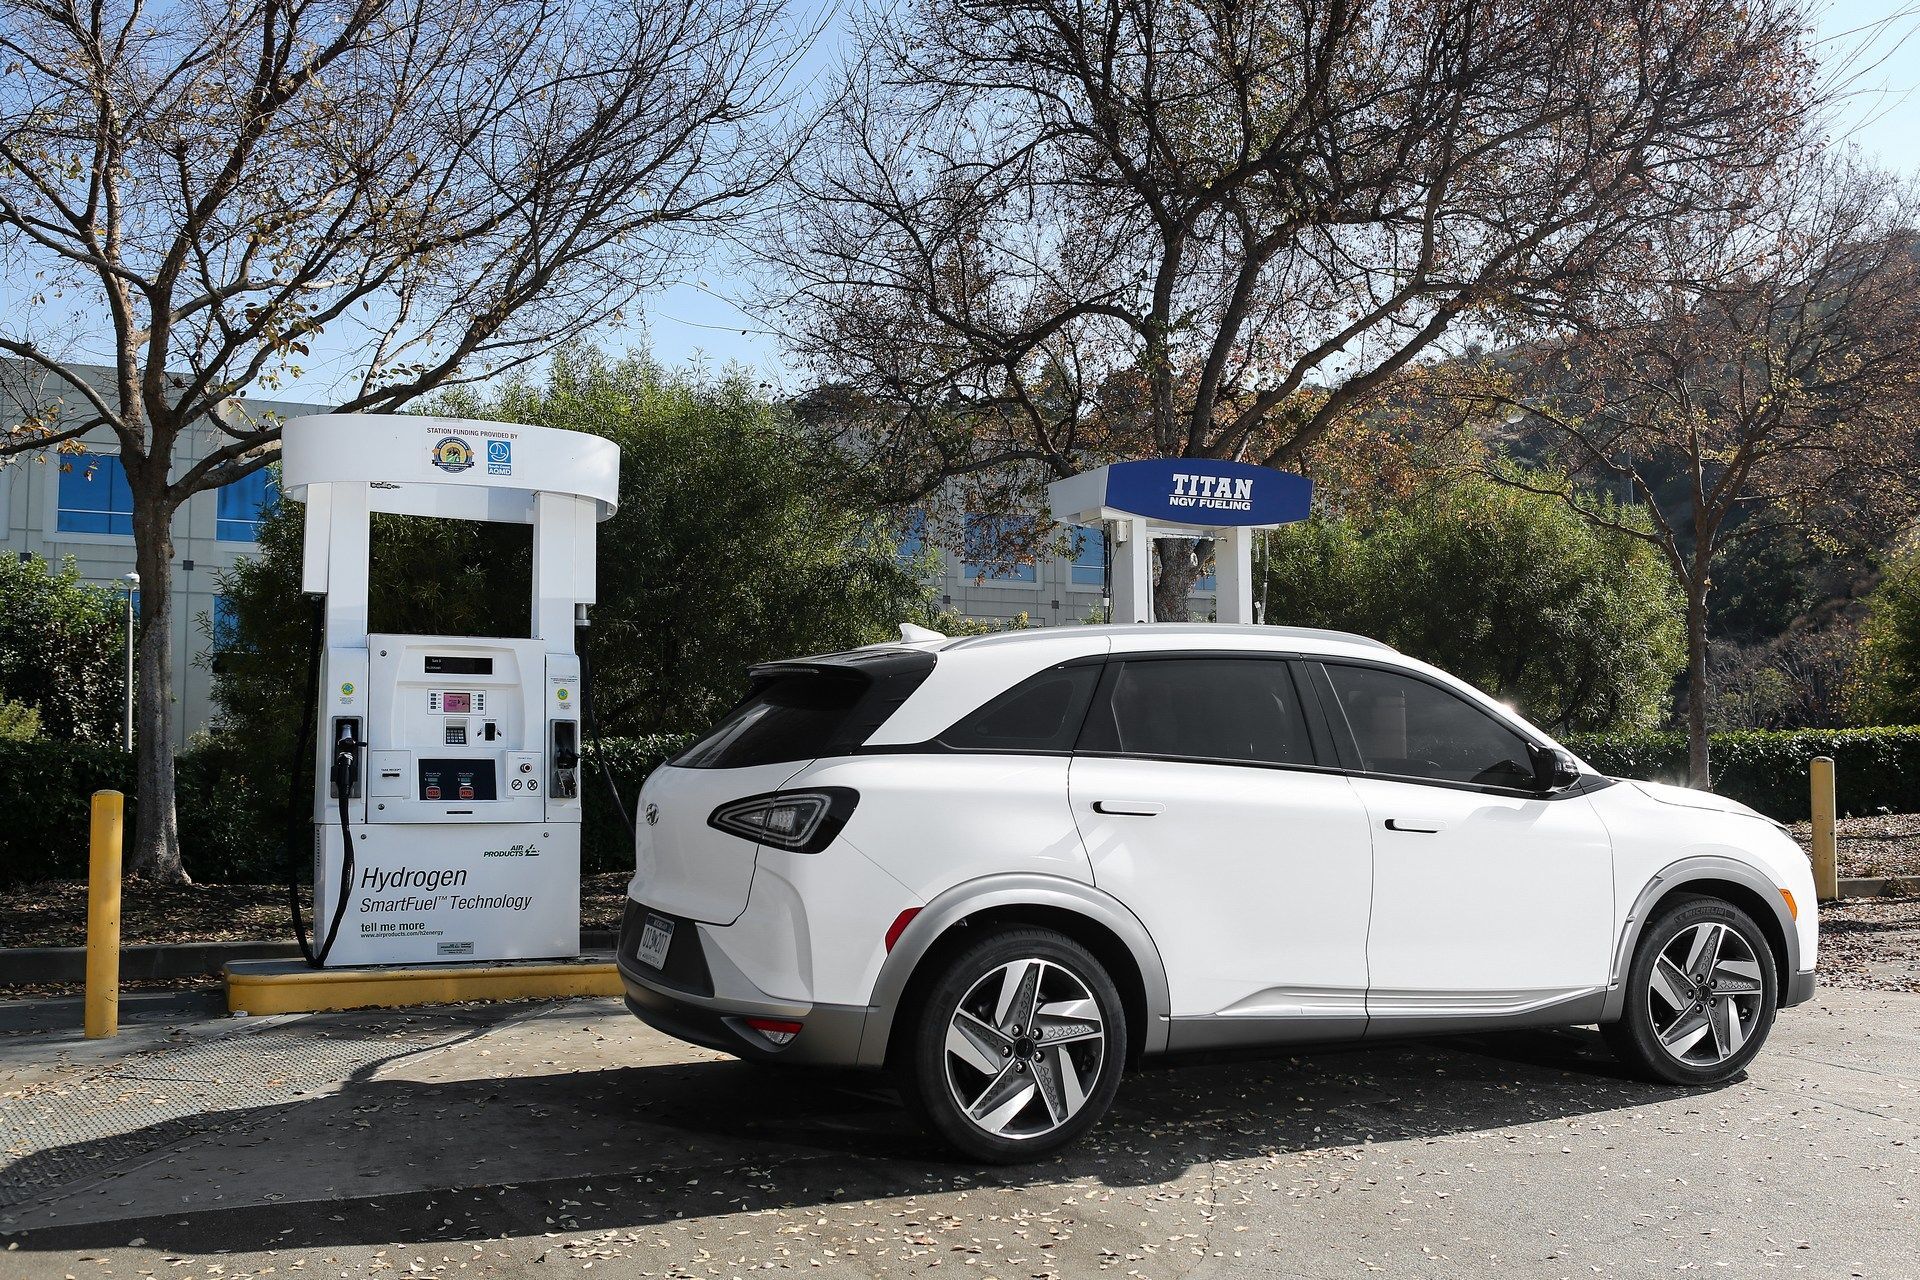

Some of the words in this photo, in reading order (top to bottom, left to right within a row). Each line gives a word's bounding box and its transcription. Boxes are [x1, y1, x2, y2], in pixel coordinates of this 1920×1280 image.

[426, 427, 452, 435] STATION
[453, 428, 479, 437] FUNDING
[480, 430, 509, 439] PROVIDED
[1172, 473, 1254, 500] TITAN
[1169, 496, 1196, 507] NGV
[1199, 498, 1251, 511] FUELING
[483, 850, 524, 858] PRODUCTS
[360, 866, 468, 893] Hydrogen
[450, 894, 533, 911] Technology
[360, 922, 377, 932] tell
[380, 923, 396, 931] me
[399, 922, 425, 931] more
[360, 930, 444, 938] www.airproducts.com/h2energy
